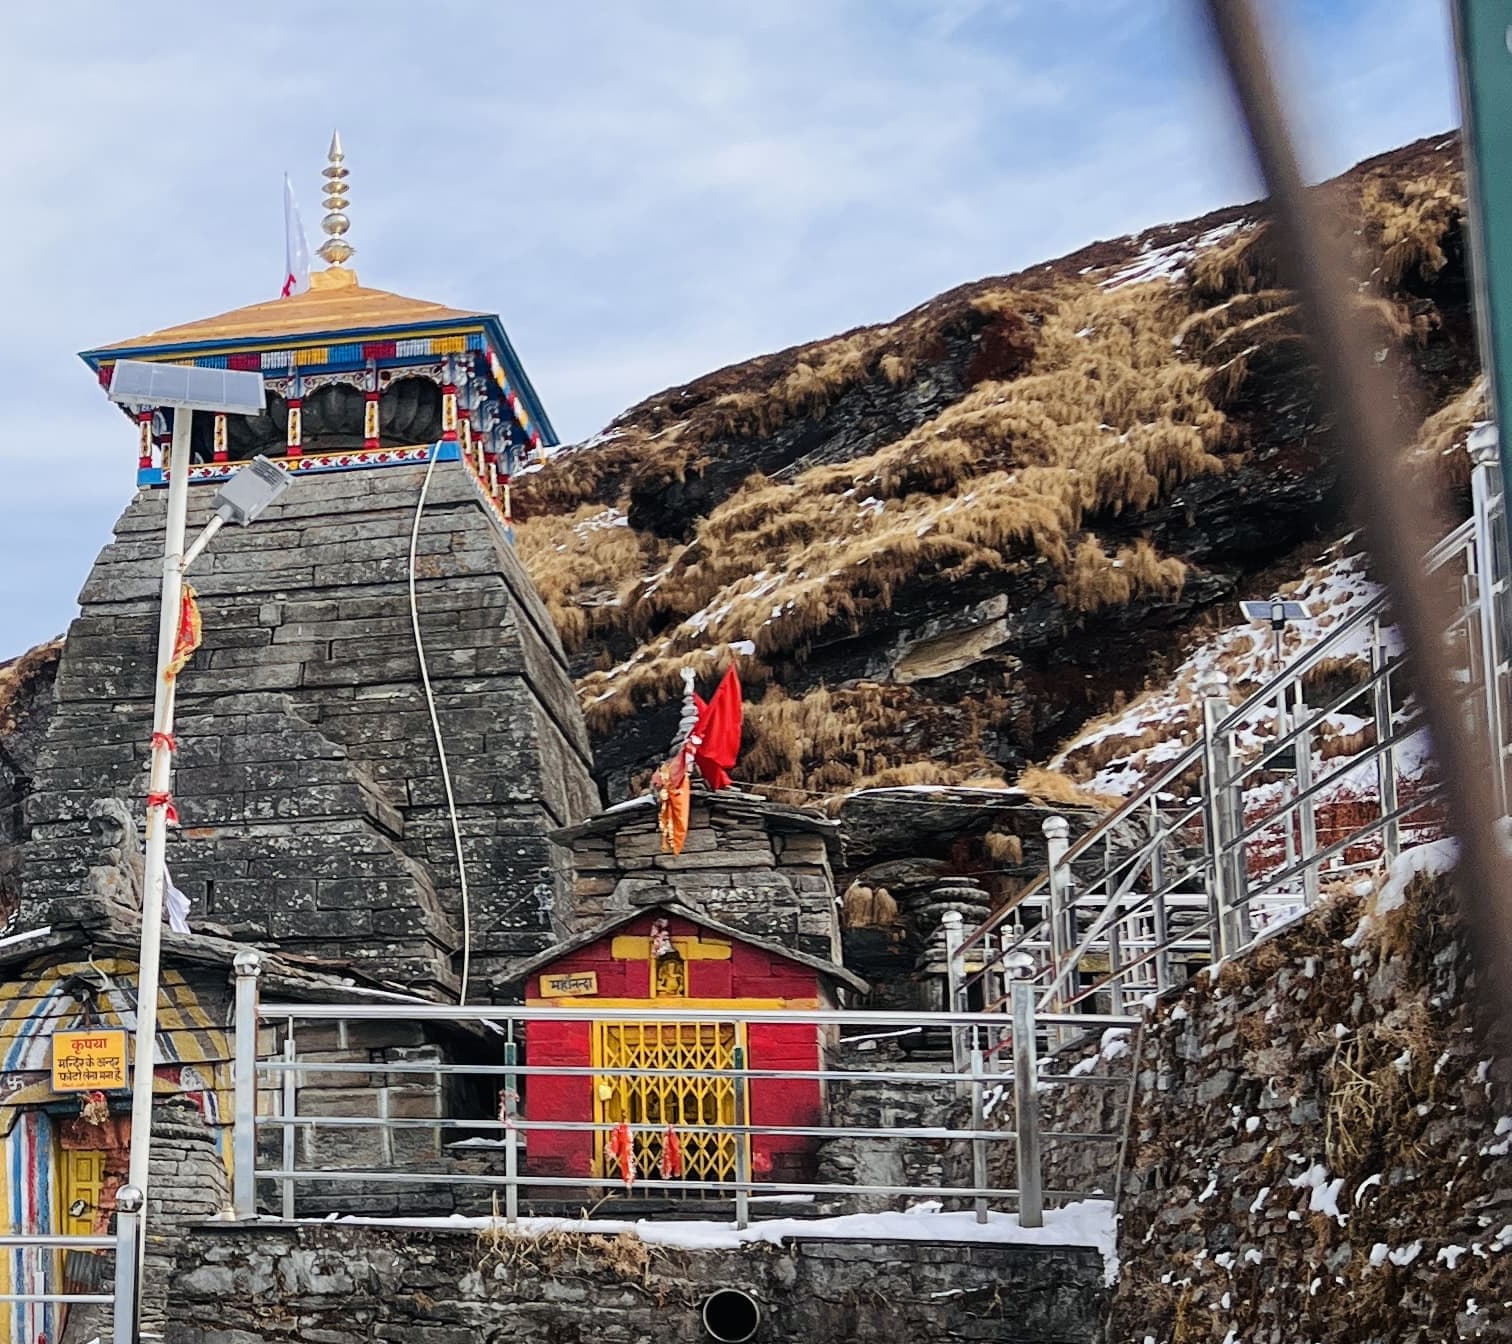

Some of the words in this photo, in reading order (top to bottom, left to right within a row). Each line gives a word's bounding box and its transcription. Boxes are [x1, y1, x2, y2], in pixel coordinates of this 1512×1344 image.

[71, 1038, 107, 1054] कृपया
[57, 1056, 84, 1069] मन्दिर
[85, 1054, 94, 1067] के
[58, 1069, 82, 1081] फोटो
